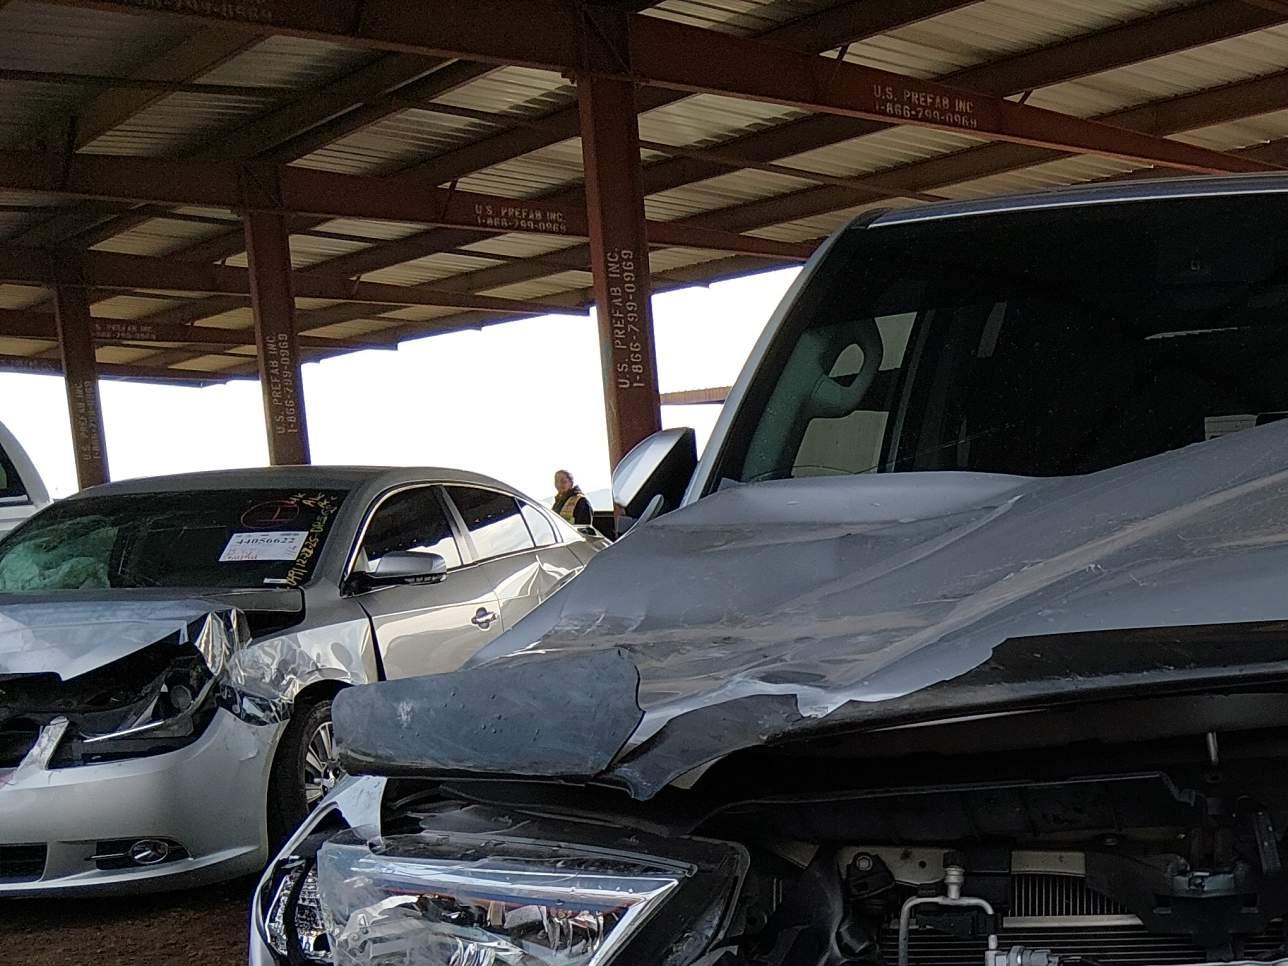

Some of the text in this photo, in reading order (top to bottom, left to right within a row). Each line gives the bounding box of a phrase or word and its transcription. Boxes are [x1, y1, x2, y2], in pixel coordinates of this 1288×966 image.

[904, 89, 950, 110] PREFAB
[501, 207, 543, 221] PREFAB
[607, 247, 631, 388] U.S. PREFAB INC.
[621, 250, 645, 387] 1-866-799-0969
[269, 360, 284, 406] PREFAB
